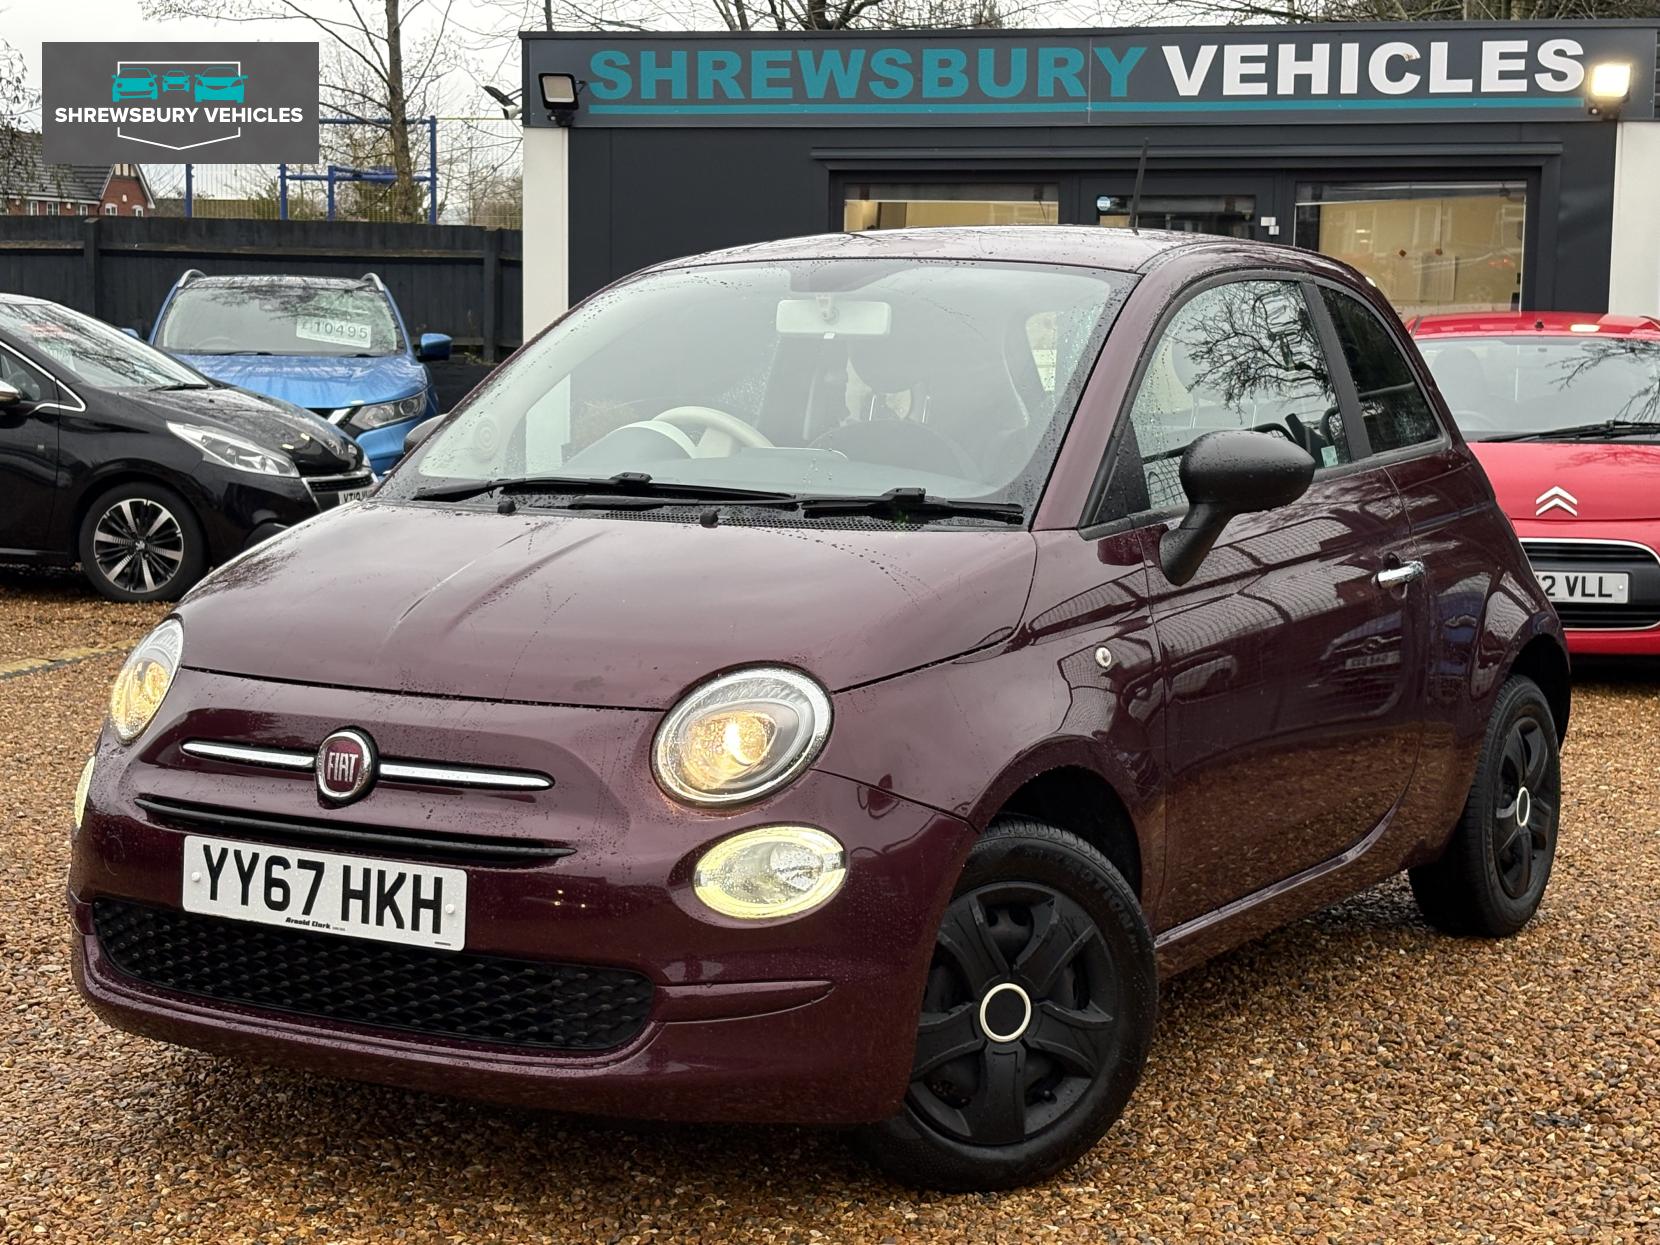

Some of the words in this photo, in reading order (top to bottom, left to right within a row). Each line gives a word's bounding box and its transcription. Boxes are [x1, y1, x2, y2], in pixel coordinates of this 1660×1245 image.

[588, 46, 1146, 101] SHREWSBURY
[1161, 38, 1585, 97] VEHICLES
[1564, 575, 1613, 598] VLL
[326, 751, 359, 783] FIAT
[202, 844, 325, 916] YY67
[340, 864, 443, 934] HKH
[285, 917, 310, 926] Arnold
[311, 920, 331, 929] Clark
